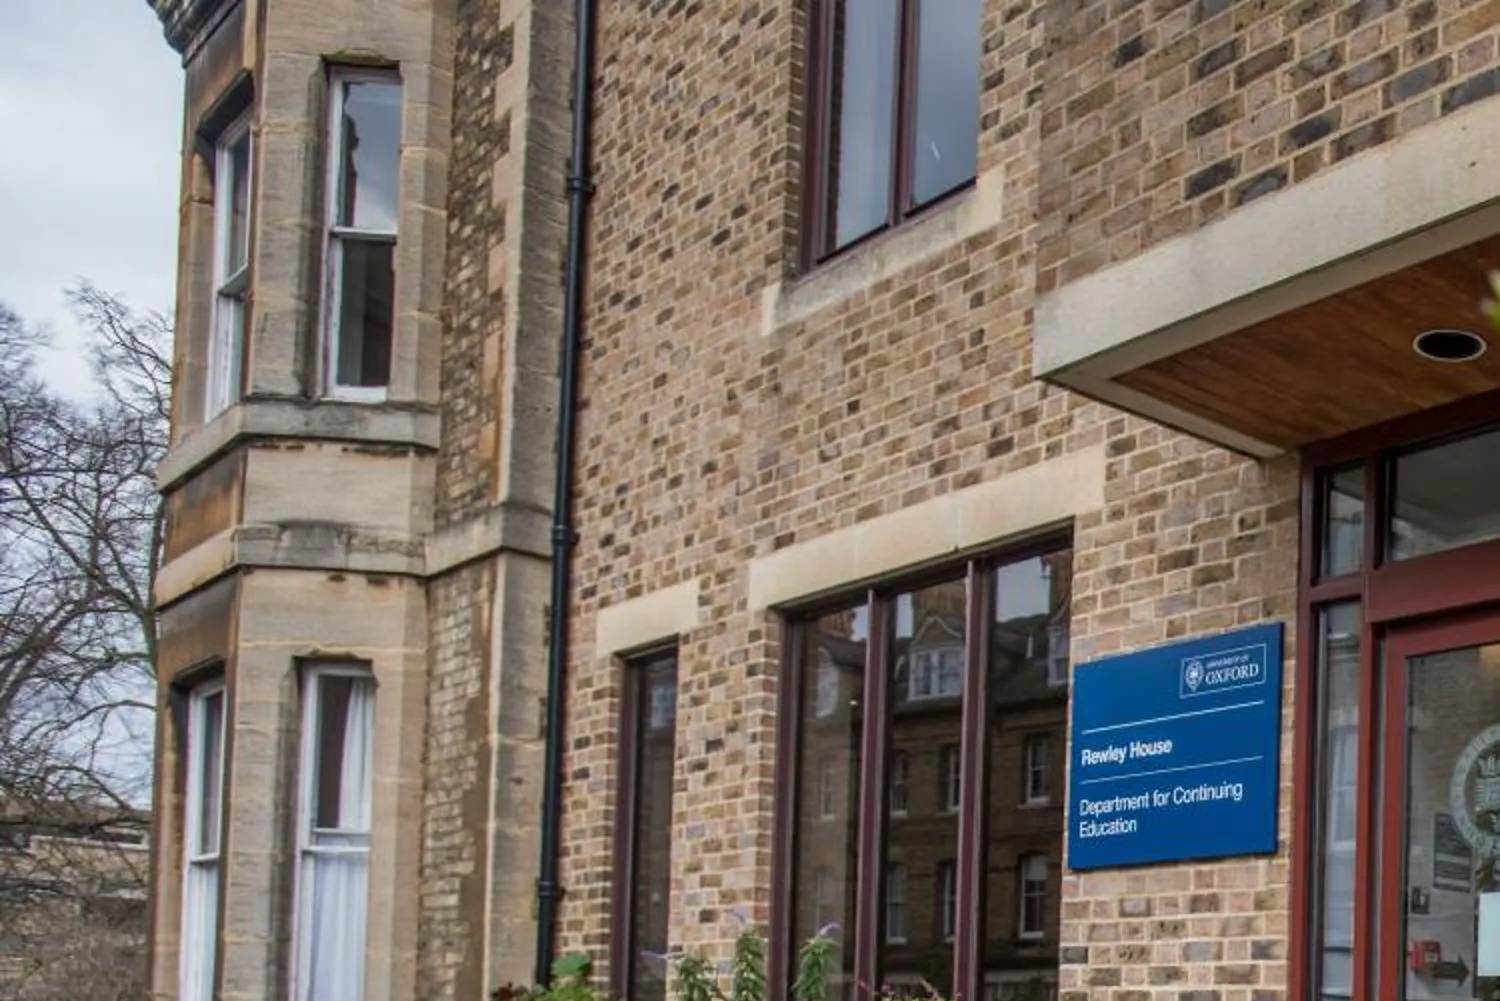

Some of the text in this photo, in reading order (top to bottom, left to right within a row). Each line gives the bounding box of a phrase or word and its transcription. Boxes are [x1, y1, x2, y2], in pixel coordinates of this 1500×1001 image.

[1205, 663, 1259, 685] OXFORD
[1081, 739, 1173, 766] Rewley House
[1079, 780, 1243, 818] Department for Continuing
[1079, 817, 1137, 839] Education
